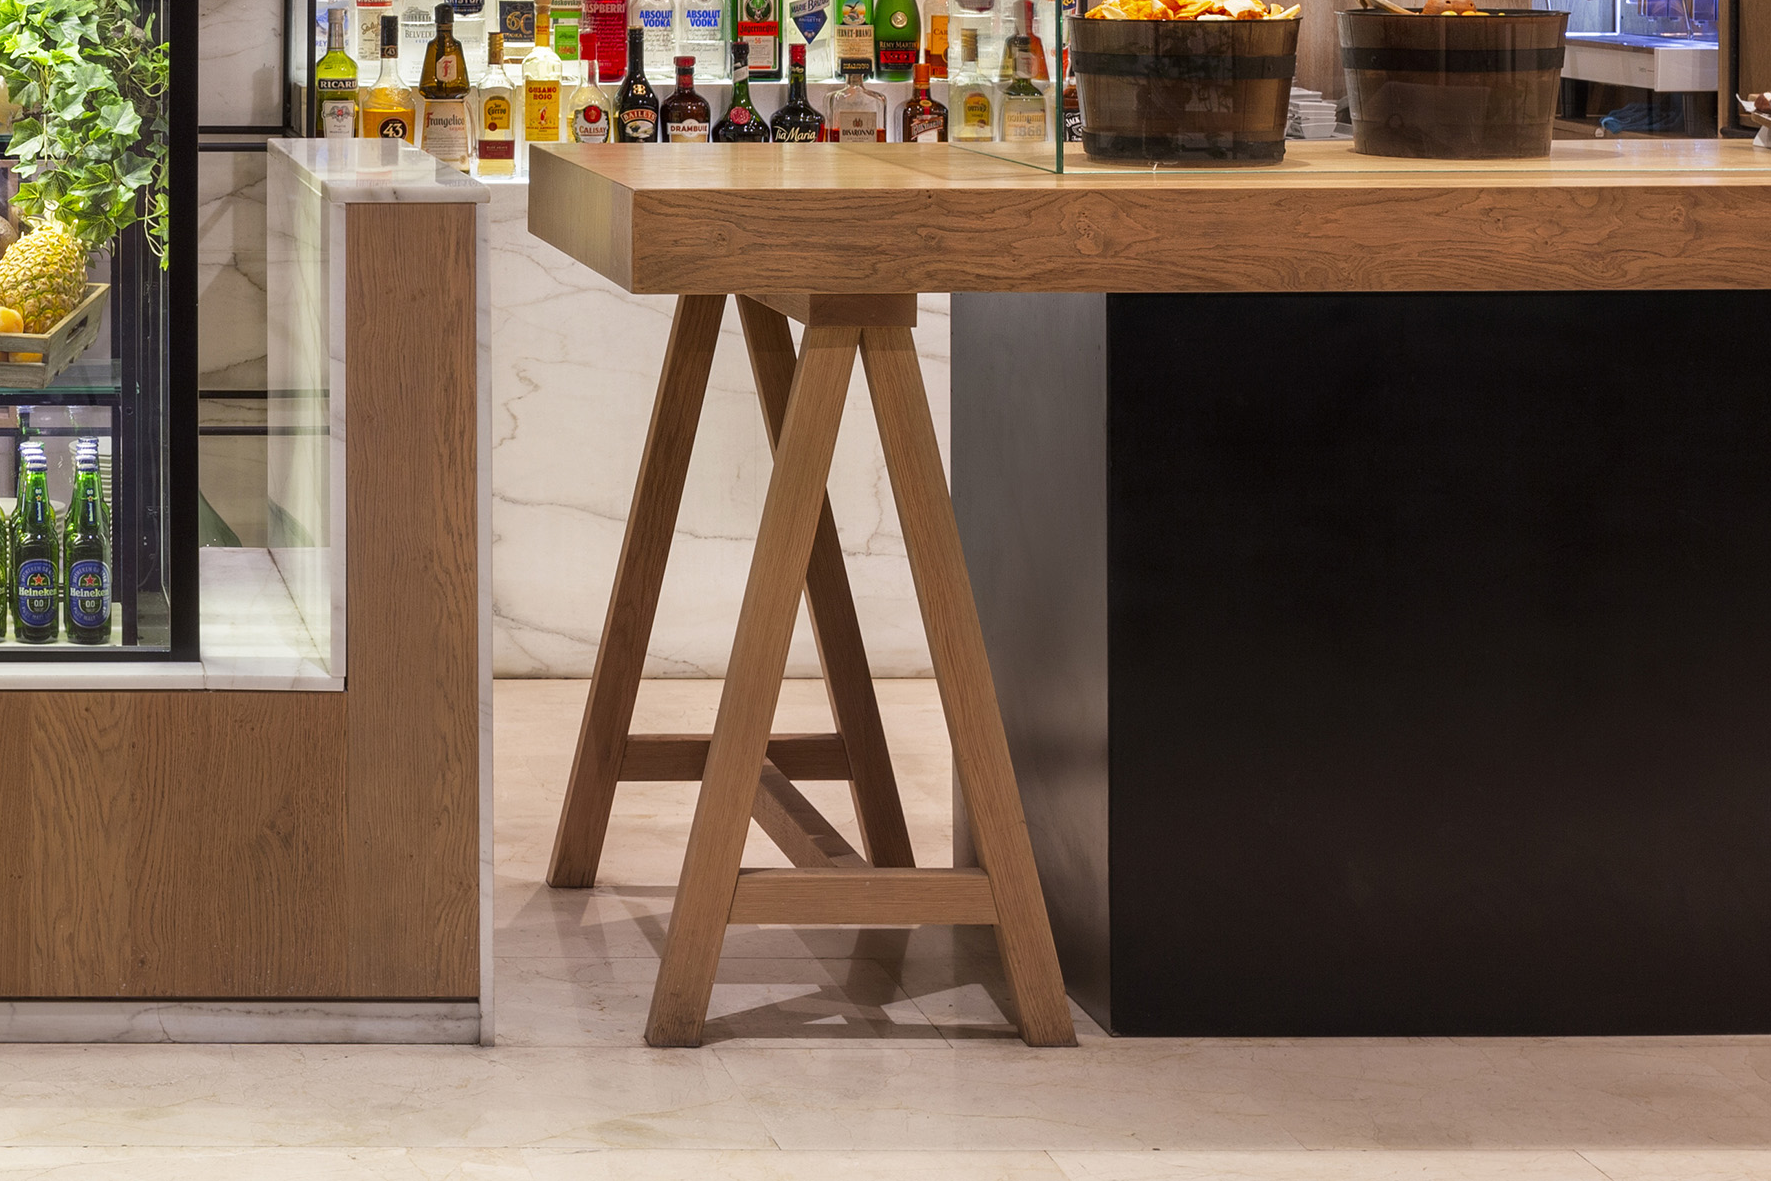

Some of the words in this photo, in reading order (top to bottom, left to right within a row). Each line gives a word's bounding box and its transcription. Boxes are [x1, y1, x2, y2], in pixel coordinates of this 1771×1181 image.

[791, 3, 807, 13] MARIE
[640, 10, 673, 19] ABSOLUT
[686, 9, 721, 19] ABSOLUT
[644, 19, 671, 27] VODKA
[690, 19, 718, 27] VODKA
[896, 40, 916, 48] MARTIN
[320, 80, 357, 88] RICARD
[488, 106, 506, 115] Cuervo
[623, 109, 656, 120] BAILEYS
[426, 111, 465, 129] Frangelico
[383, 123, 403, 138] 43
[578, 125, 606, 133] CALISAY
[842, 129, 874, 137] DISARONNO
[772, 126, 787, 141] Tia
[785, 127, 816, 142] Maria
[18, 587, 57, 597] Heineken
[70, 587, 109, 597] Heineken
